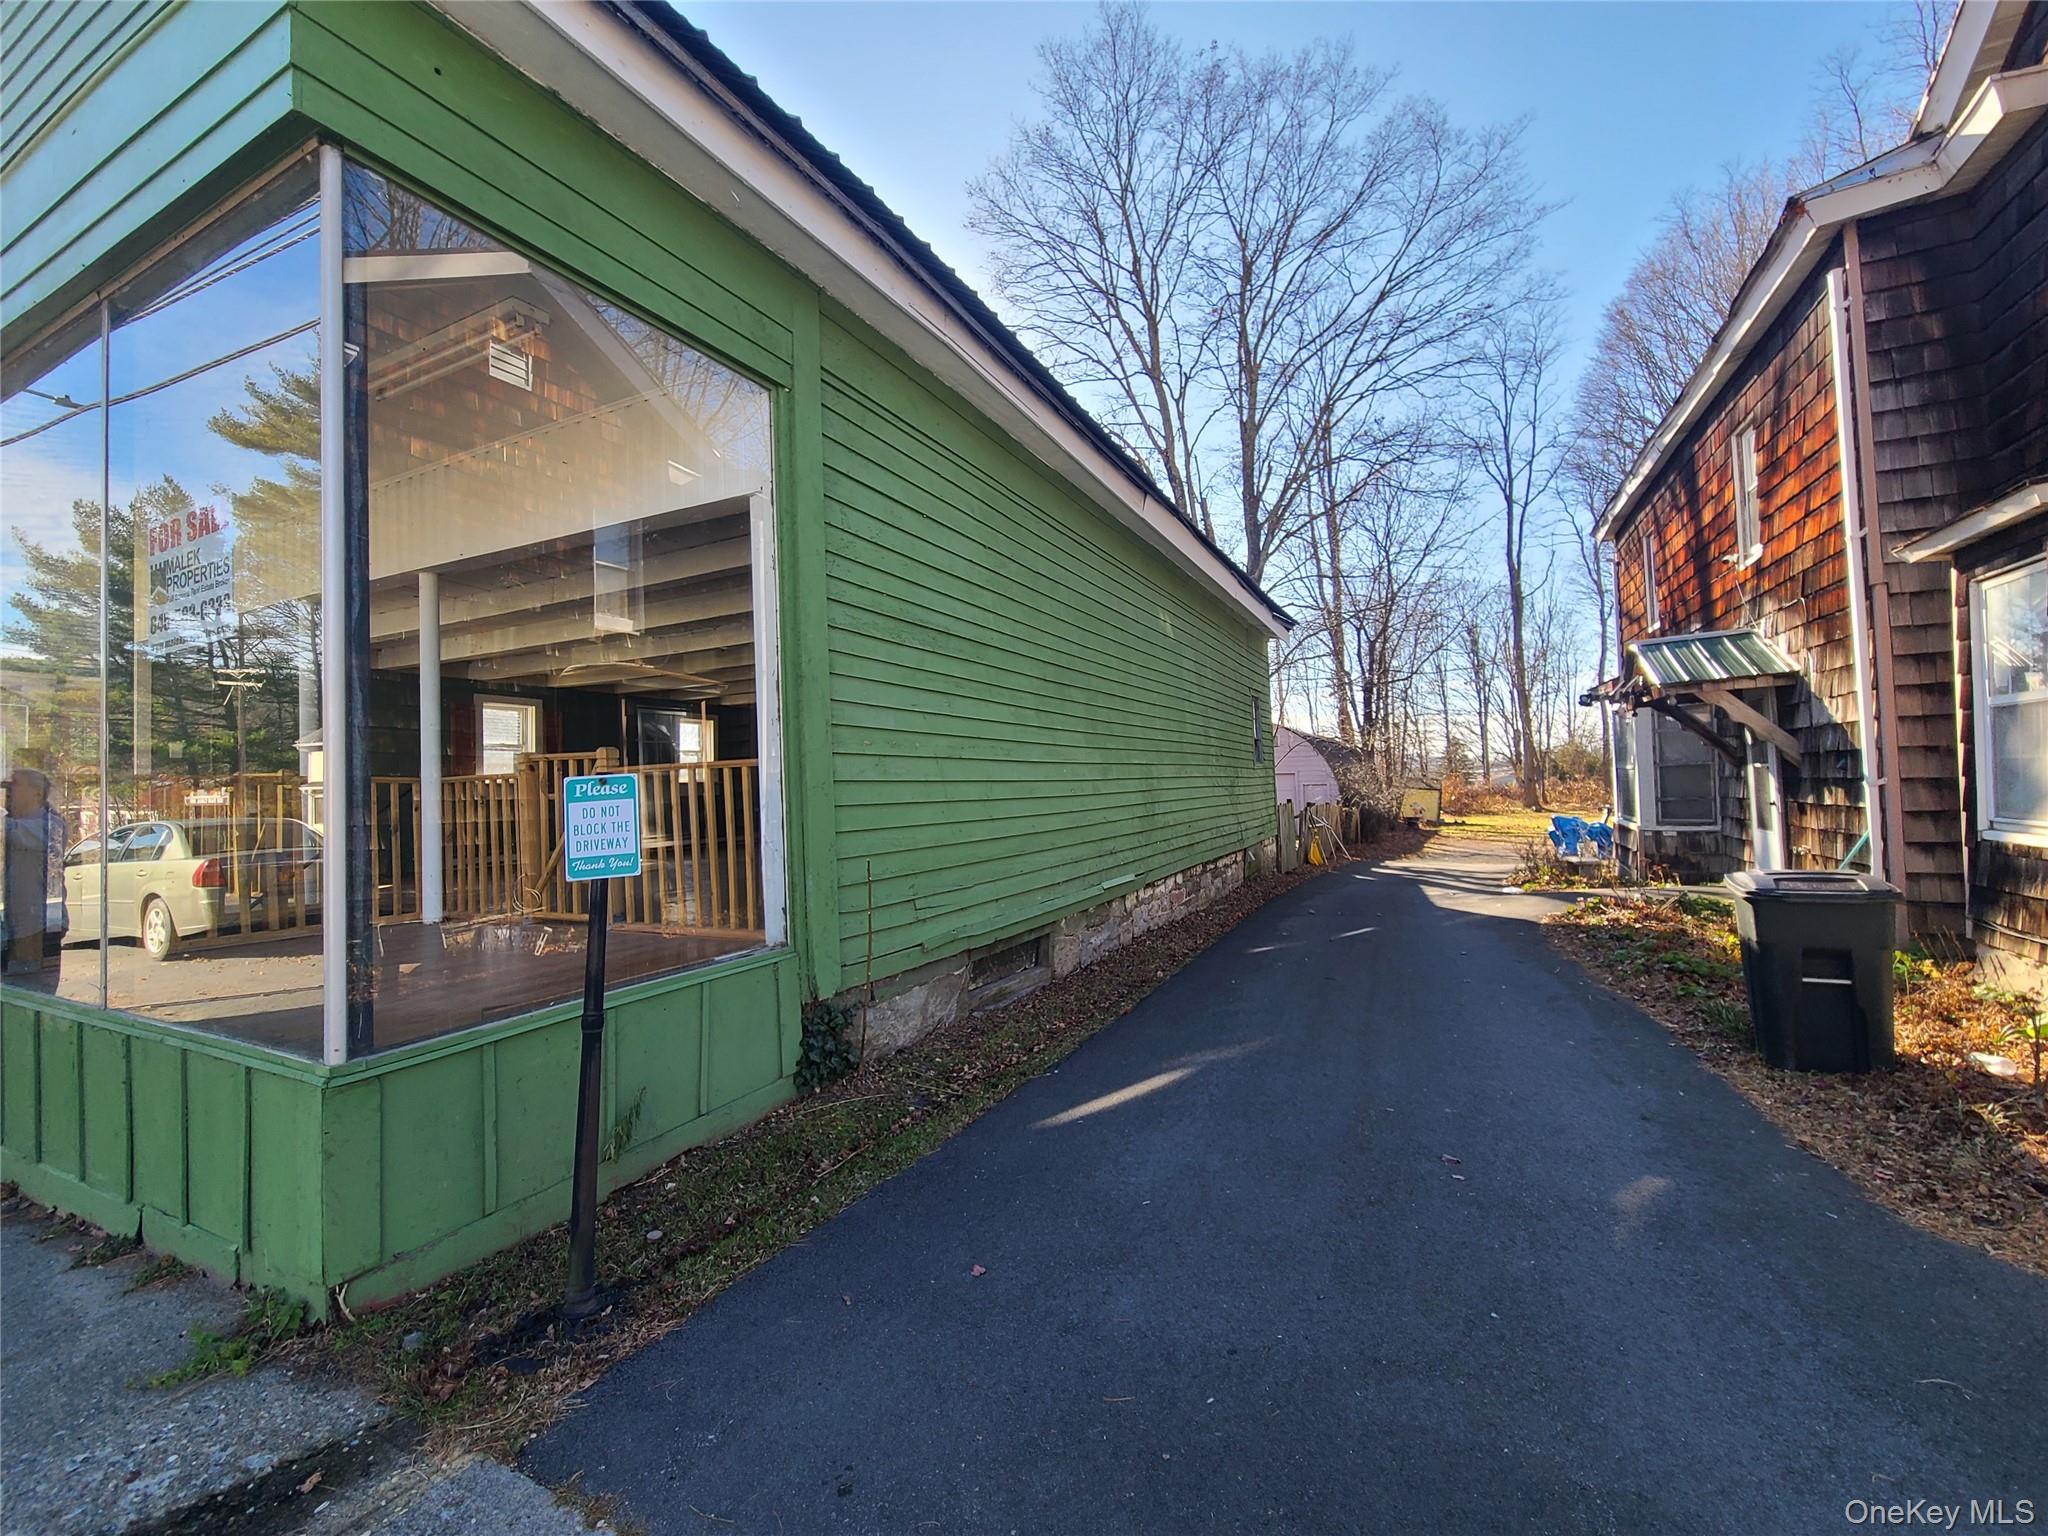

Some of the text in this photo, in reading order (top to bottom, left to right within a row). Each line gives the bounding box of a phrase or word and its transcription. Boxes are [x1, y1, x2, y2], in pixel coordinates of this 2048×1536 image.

[149, 505, 229, 557] FOR SAL
[166, 547, 201, 575] MALEK
[166, 556, 230, 596] PROPERTIES
[574, 781, 628, 797] Please
[582, 805, 620, 819] DO NOT
[573, 820, 630, 836] BLOCK THE
[575, 837, 628, 853] DRIVEWAY
[572, 856, 634, 871] Thank You!
